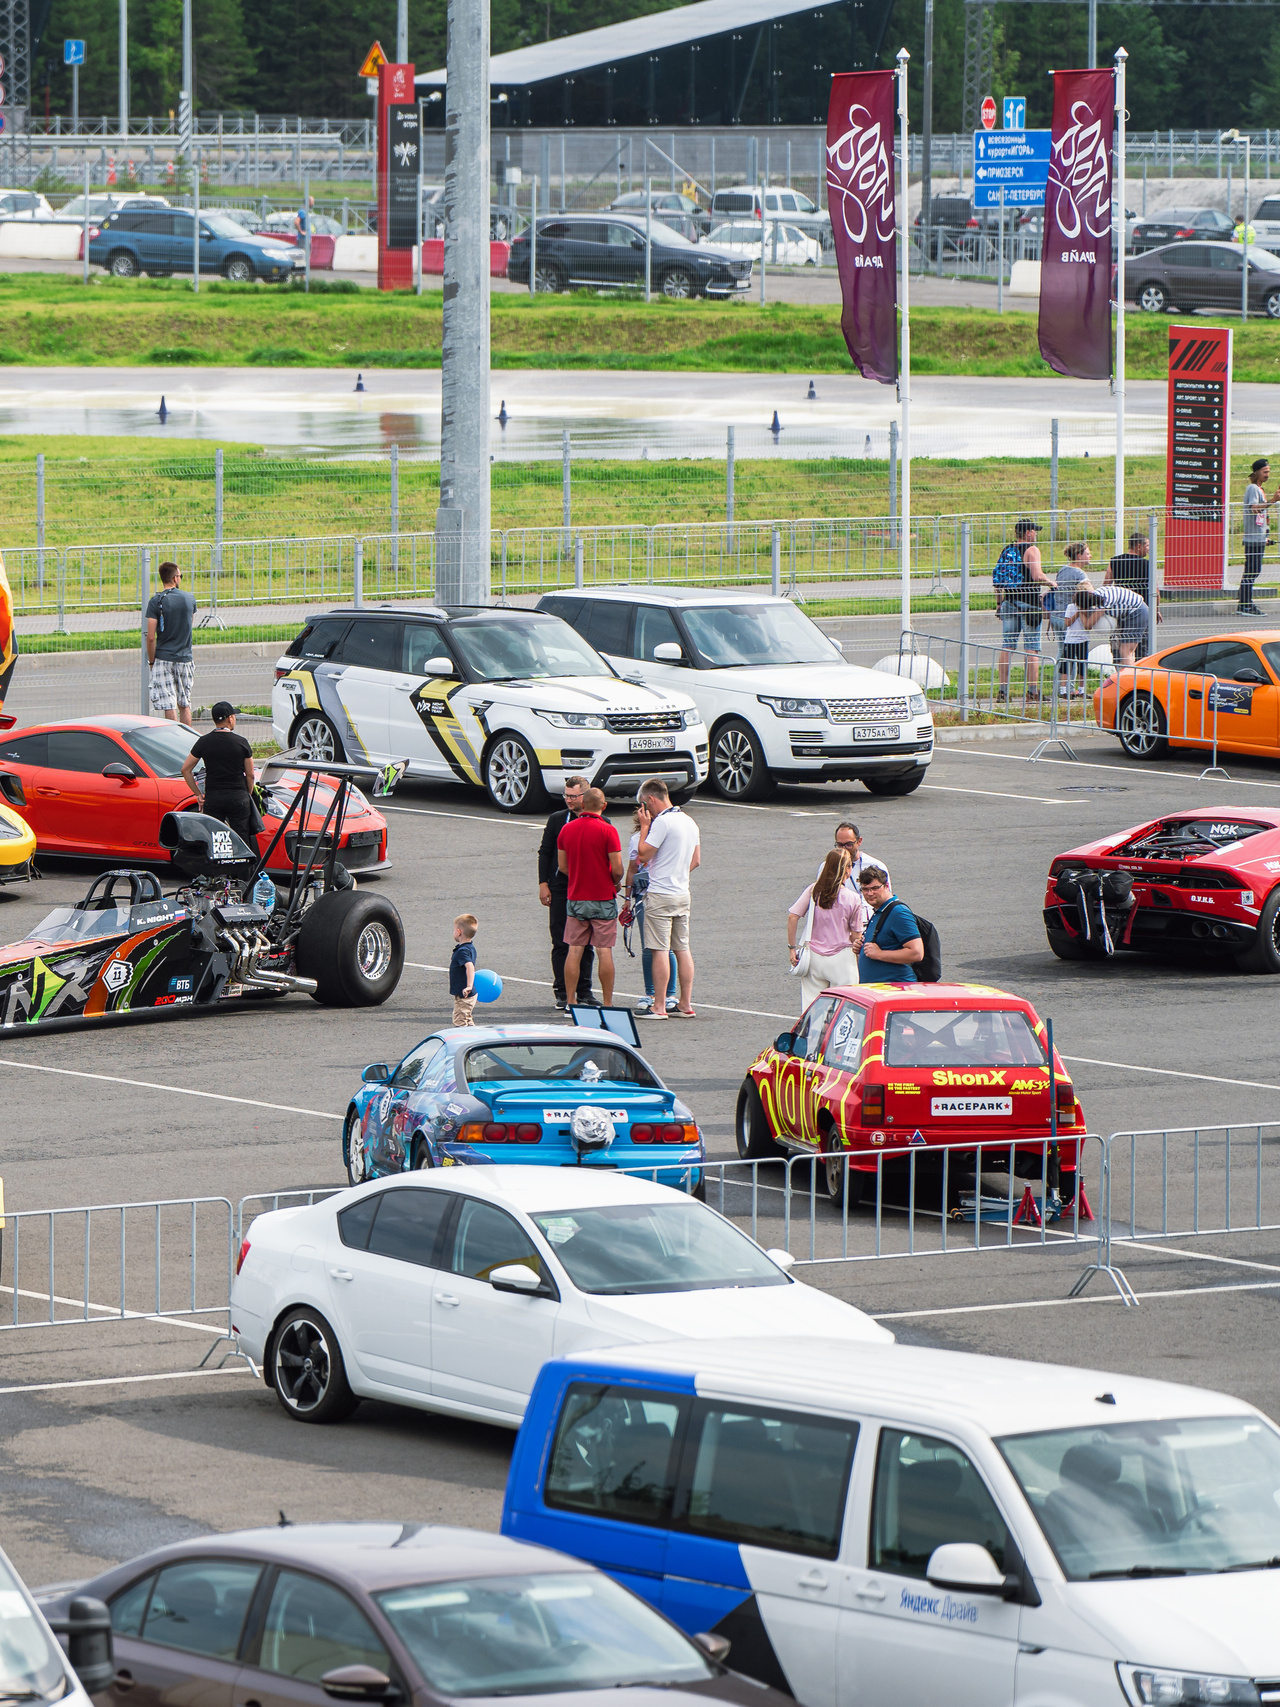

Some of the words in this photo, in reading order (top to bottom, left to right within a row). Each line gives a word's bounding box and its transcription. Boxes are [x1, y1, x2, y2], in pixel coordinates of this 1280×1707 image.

[982, 108, 996, 120] STOP
[987, 167, 1024, 178] ПРИОЗЕРСК
[987, 189, 1045, 202] САНТ-ПЕТЕРБУРГ
[1209, 823, 1240, 836] NGK
[211, 830, 232, 843] MAX
[213, 842, 234, 854] RIDE
[136, 918, 147, 926] K.
[146, 913, 175, 924] NIGHT
[112, 970, 122, 981] 11
[176, 979, 191, 991] ВТБ
[932, 1070, 1008, 1086] ShonX
[941, 1102, 1004, 1111] RACEPARK
[900, 1587, 940, 1615] Яндекс
[940, 1594, 978, 1623] Драйв
